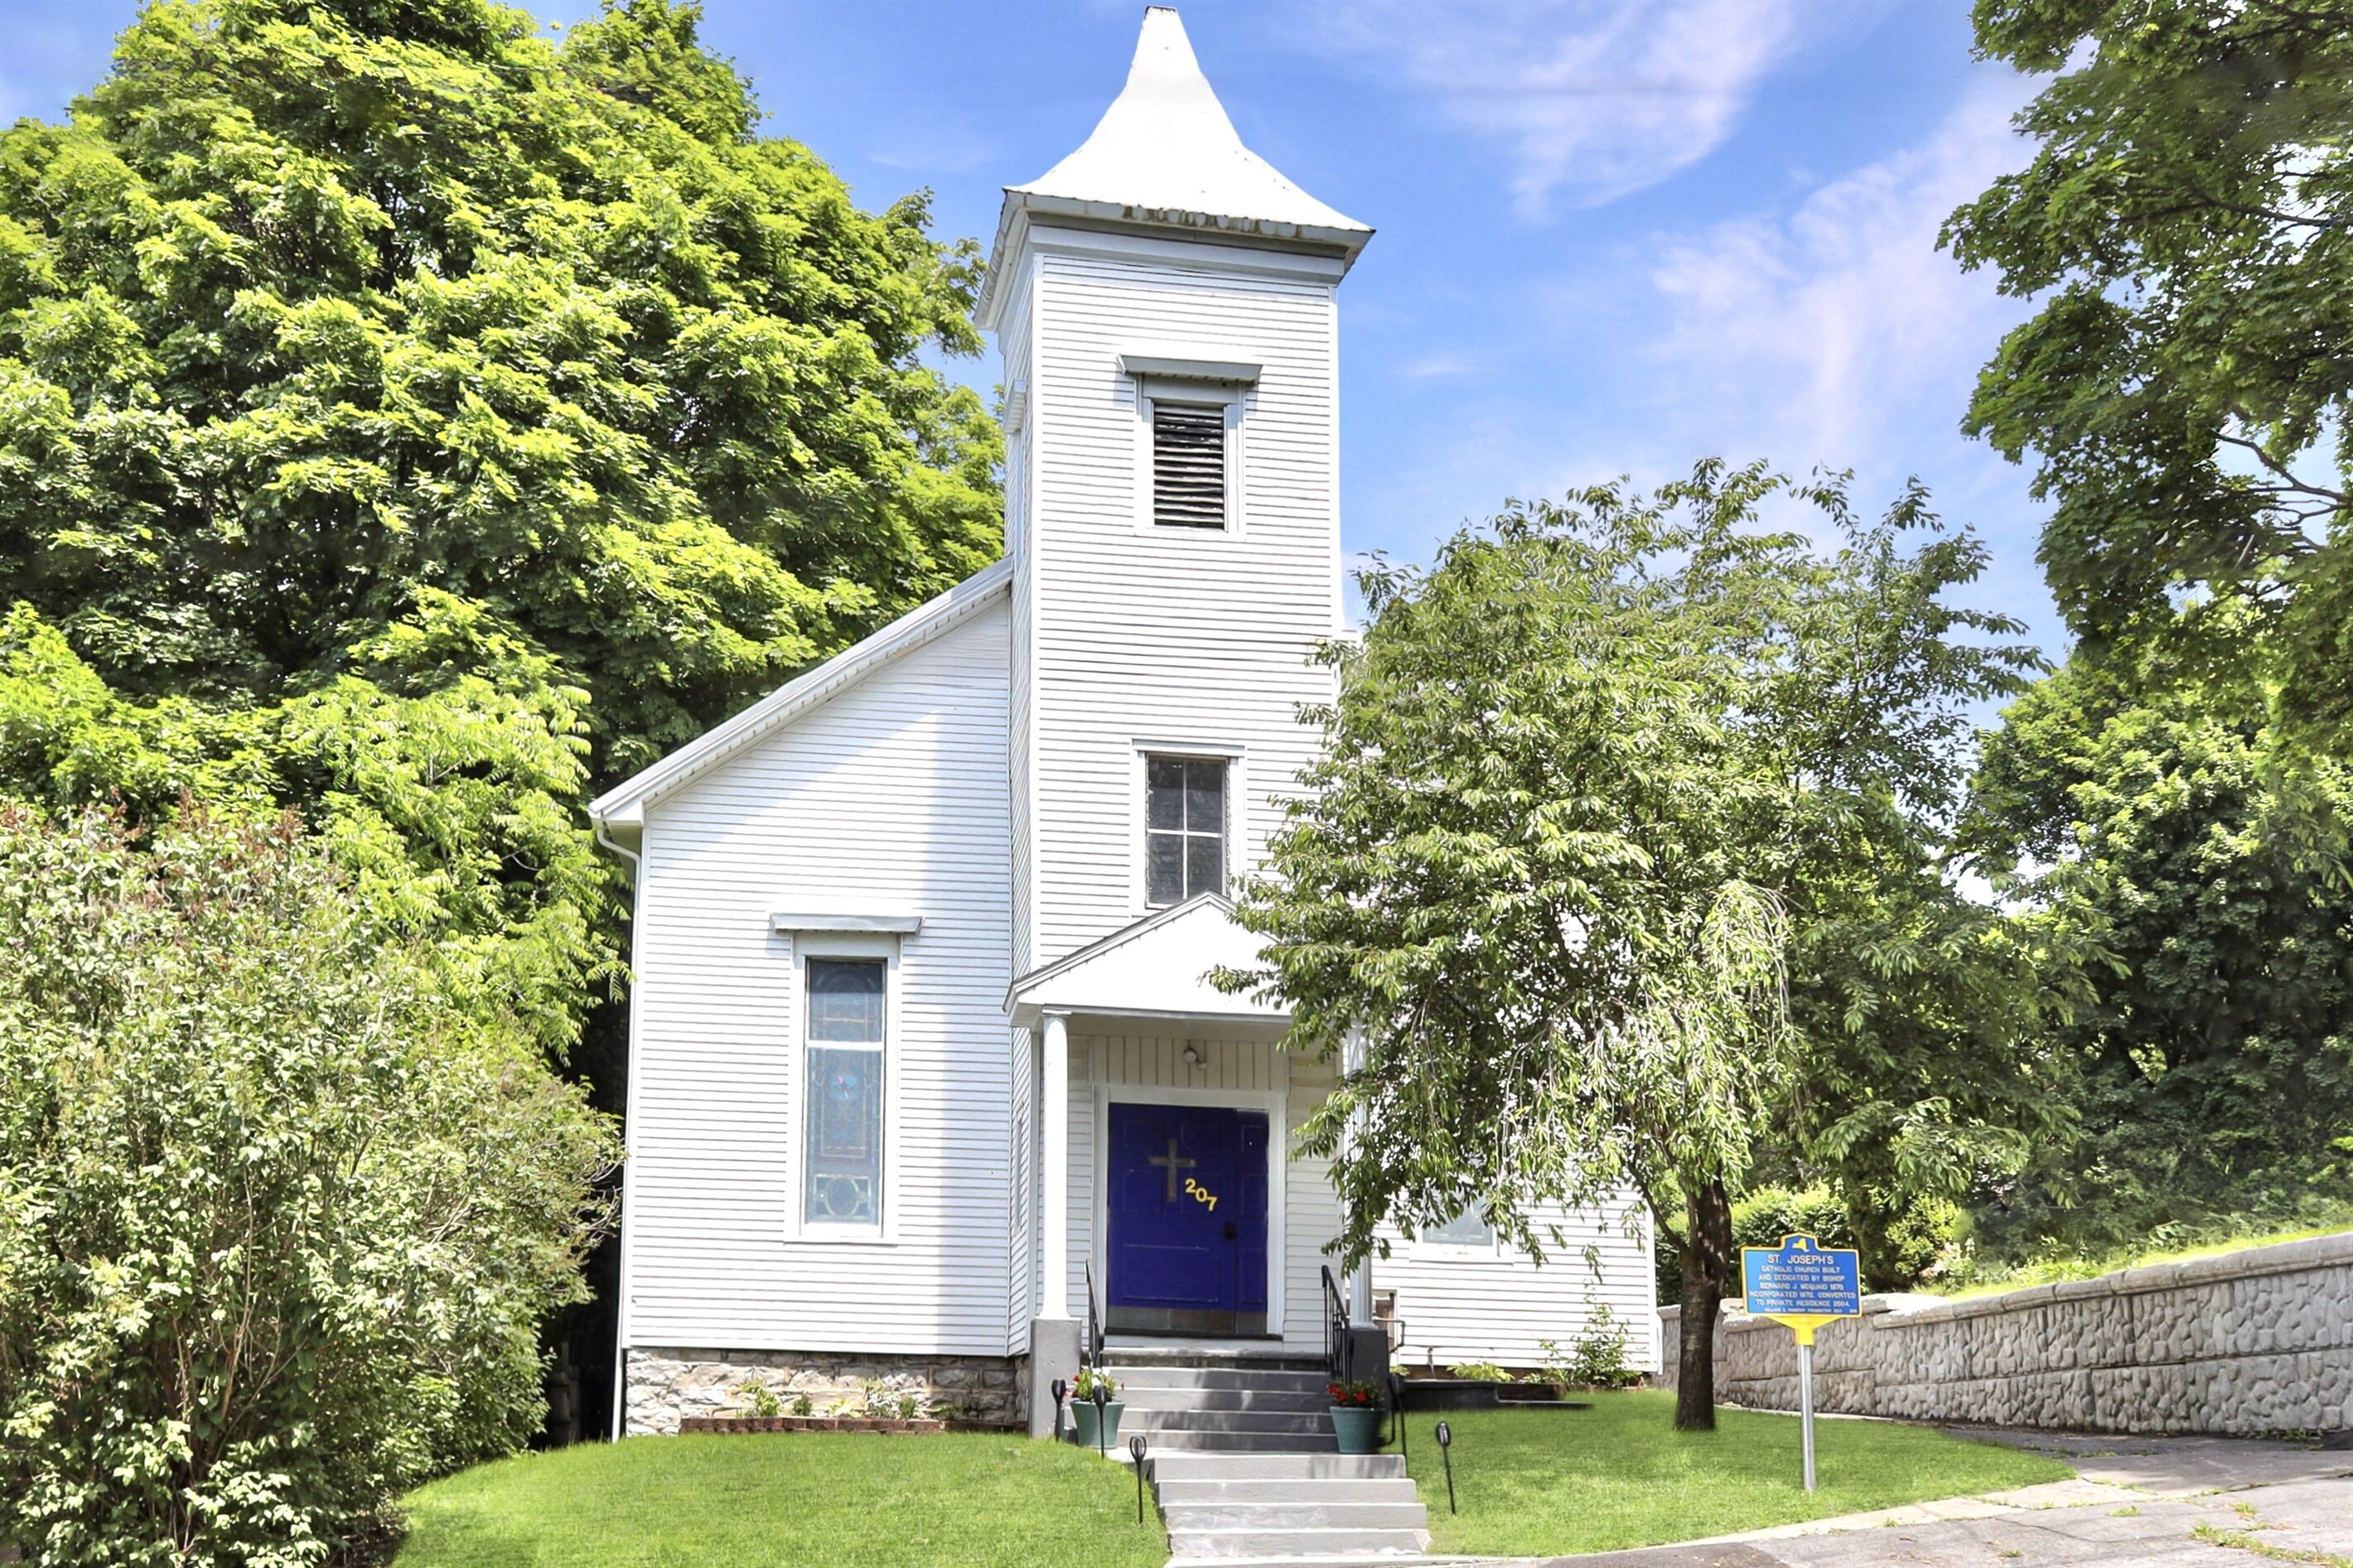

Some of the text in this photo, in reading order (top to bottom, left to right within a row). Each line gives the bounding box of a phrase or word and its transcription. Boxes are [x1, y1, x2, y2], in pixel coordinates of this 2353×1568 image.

[1185, 1178, 1217, 1212] 207
[1767, 1254, 1834, 1265] ST. JOSEPH'S
